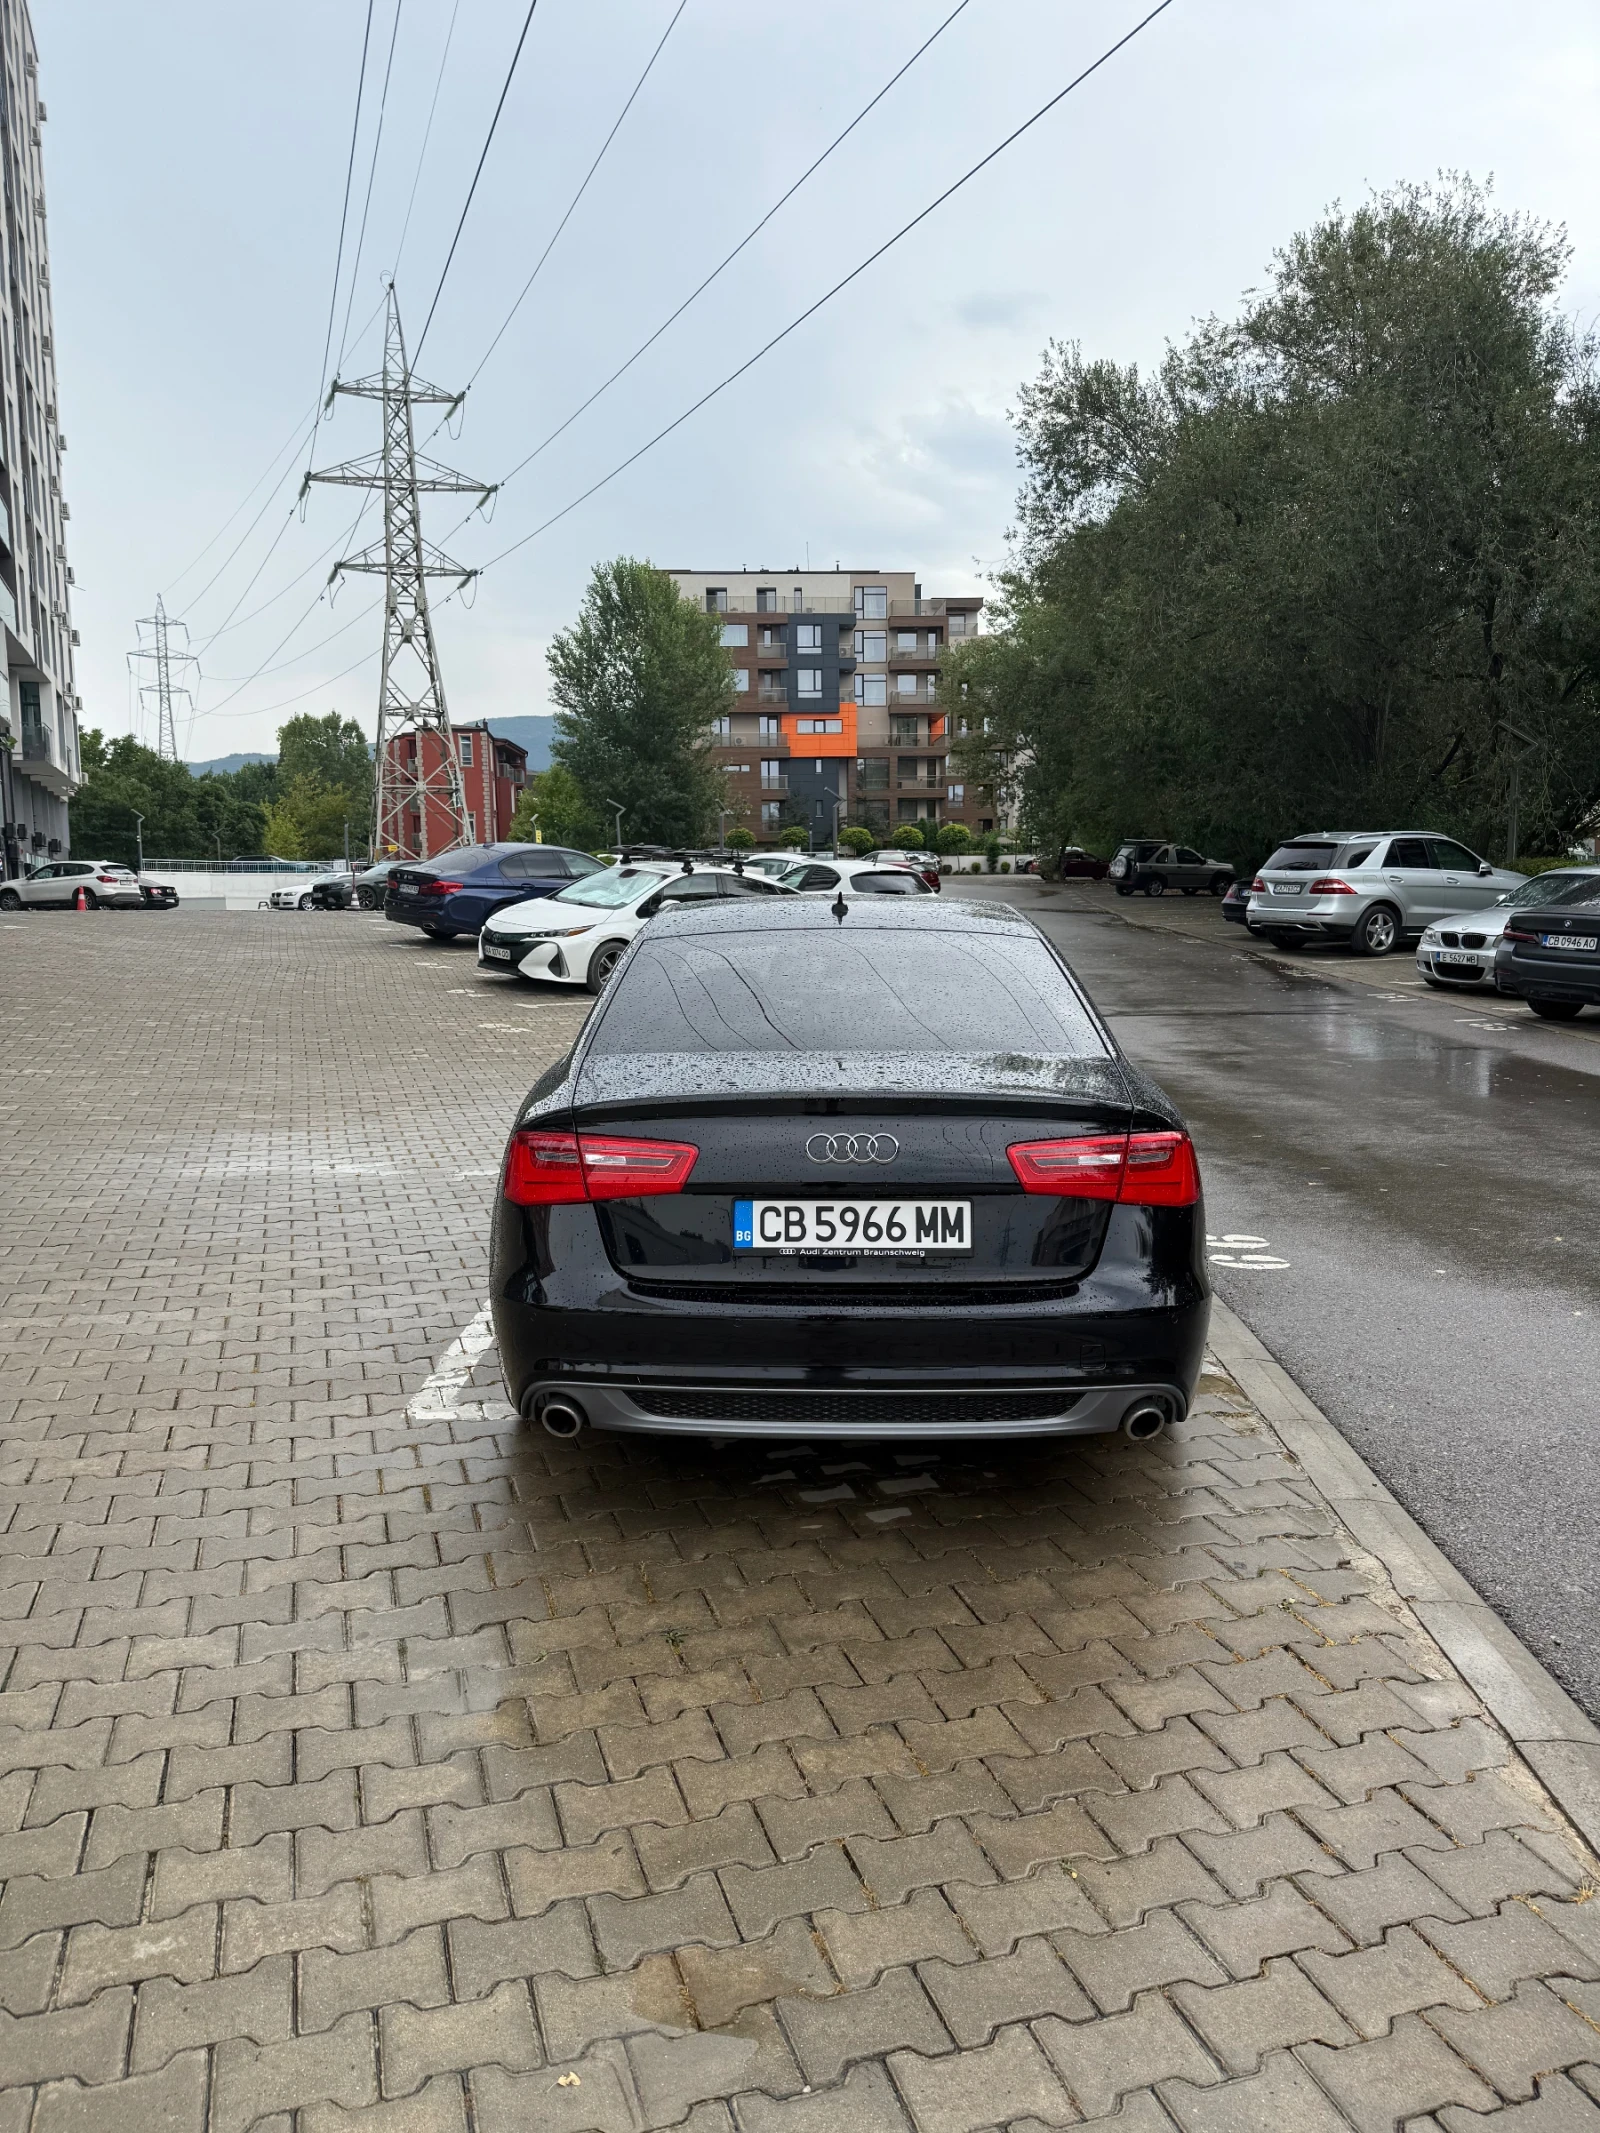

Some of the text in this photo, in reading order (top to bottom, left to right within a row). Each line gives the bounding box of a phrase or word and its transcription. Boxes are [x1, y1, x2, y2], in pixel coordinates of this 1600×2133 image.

[1548, 936, 1596, 948] CB 0946 AO
[1442, 953, 1447, 962] E
[1449, 954, 1466, 963] 5627
[736, 1206, 964, 1243] BG CB 5966 MM
[800, 1248, 925, 1257] Audi Zentrum Braunschweig
